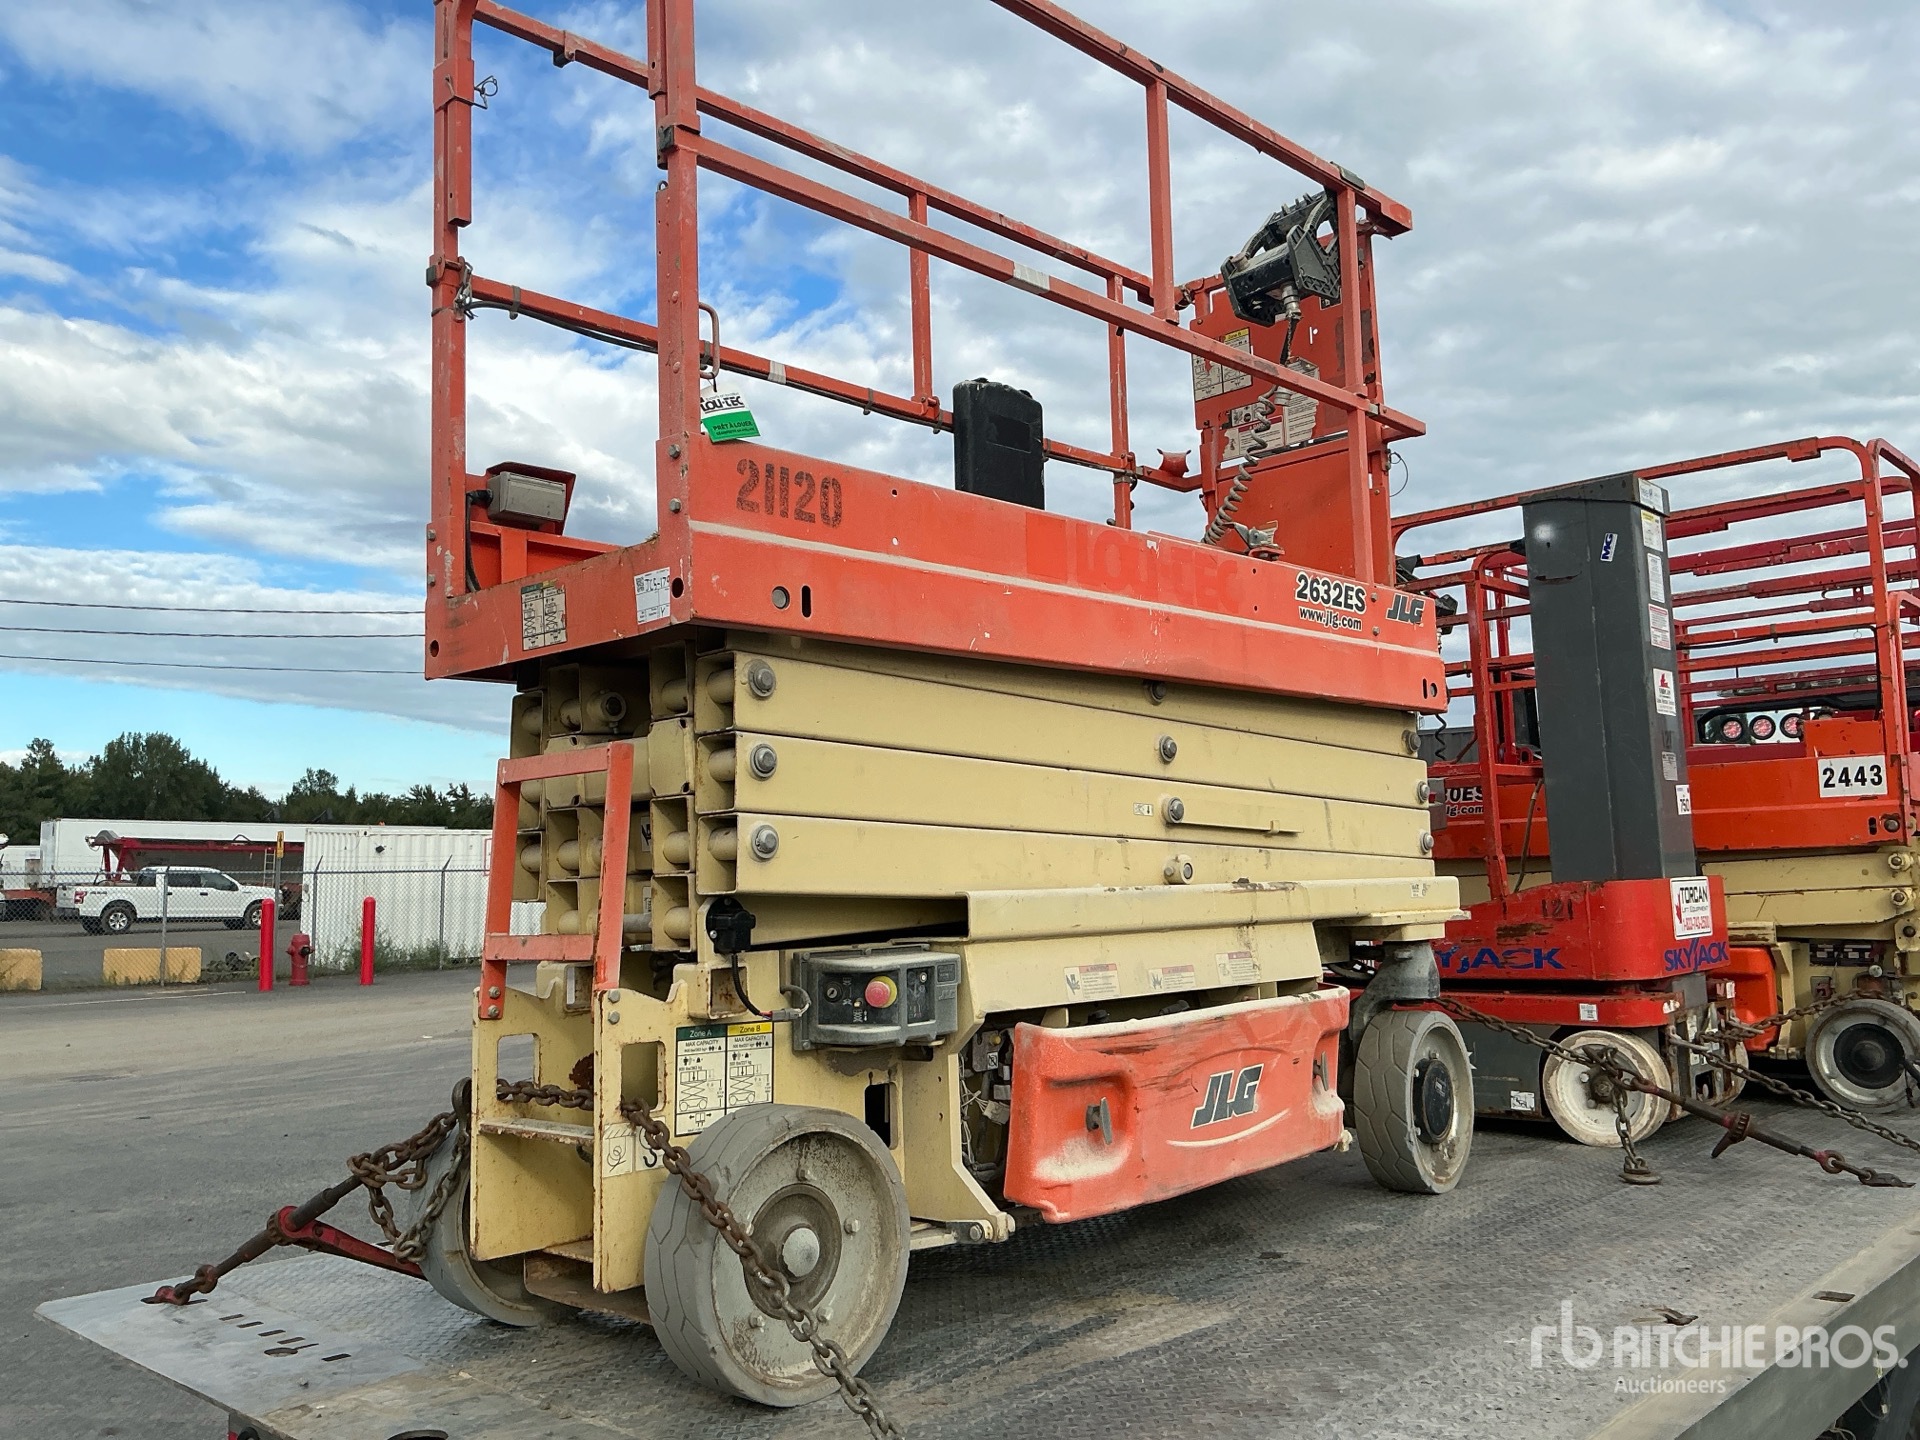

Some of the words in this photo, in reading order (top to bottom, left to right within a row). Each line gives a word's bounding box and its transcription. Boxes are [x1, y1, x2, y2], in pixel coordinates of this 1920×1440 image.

[734, 420, 753, 428] LOUER
[736, 458, 843, 528] 21120
[1297, 573, 1366, 613] 2632ES
[1300, 607, 1362, 630] www.jlg.com
[1387, 593, 1424, 624] JLG
[1822, 764, 1883, 788] 2443
[1680, 885, 1708, 904] TORCAN
[1664, 938, 1729, 972] SKYJACK
[689, 1030, 706, 1038] Zone
[1191, 1064, 1264, 1129] JLG
